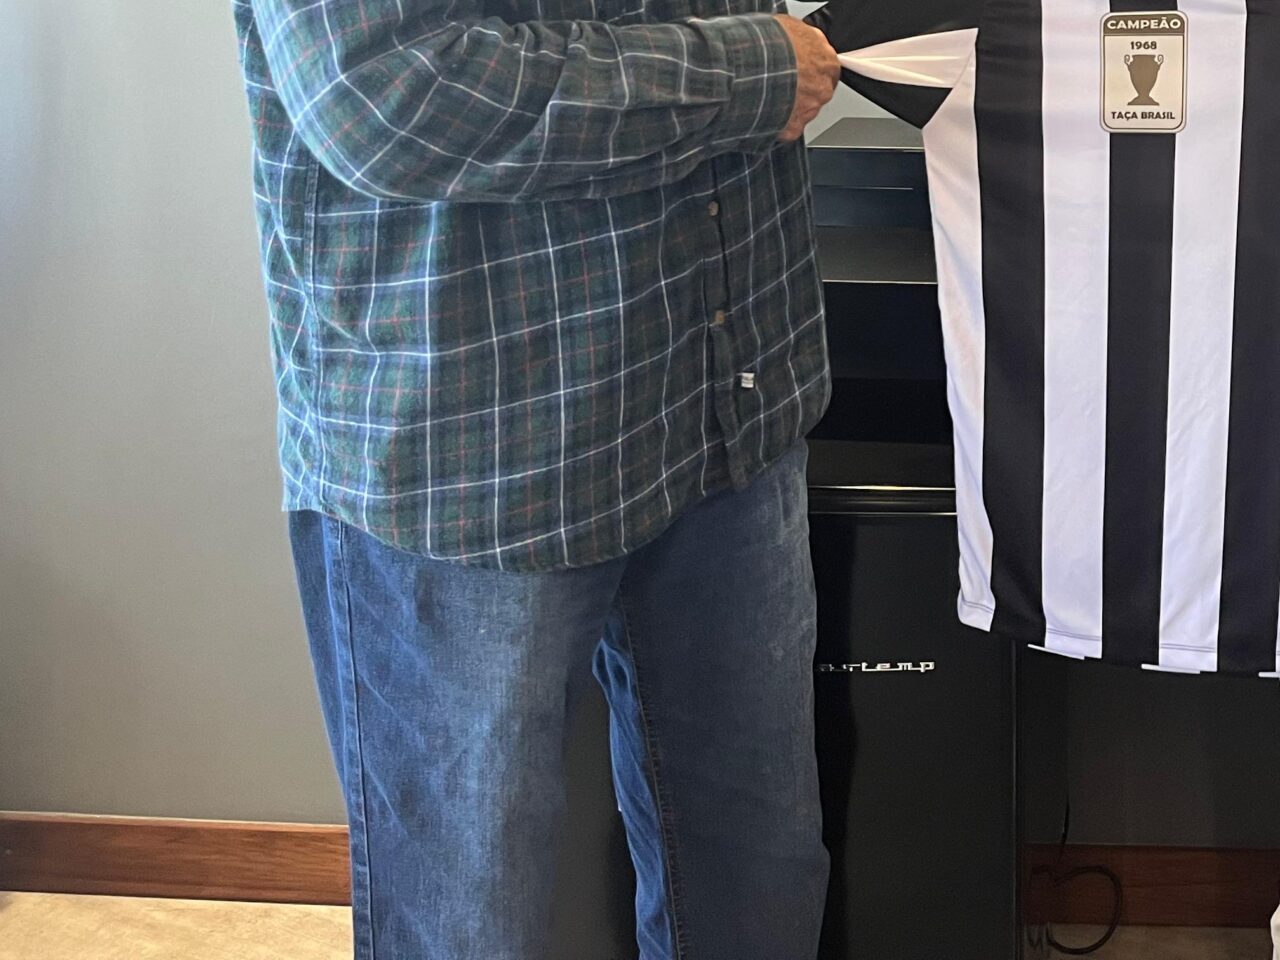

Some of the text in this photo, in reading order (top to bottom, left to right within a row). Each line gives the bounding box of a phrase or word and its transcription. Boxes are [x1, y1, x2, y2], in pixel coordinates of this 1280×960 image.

[1107, 16, 1181, 29] CAMPEÃO
[1130, 41, 1157, 50] 1968
[1111, 111, 1175, 121] TAÇA BRASIL
